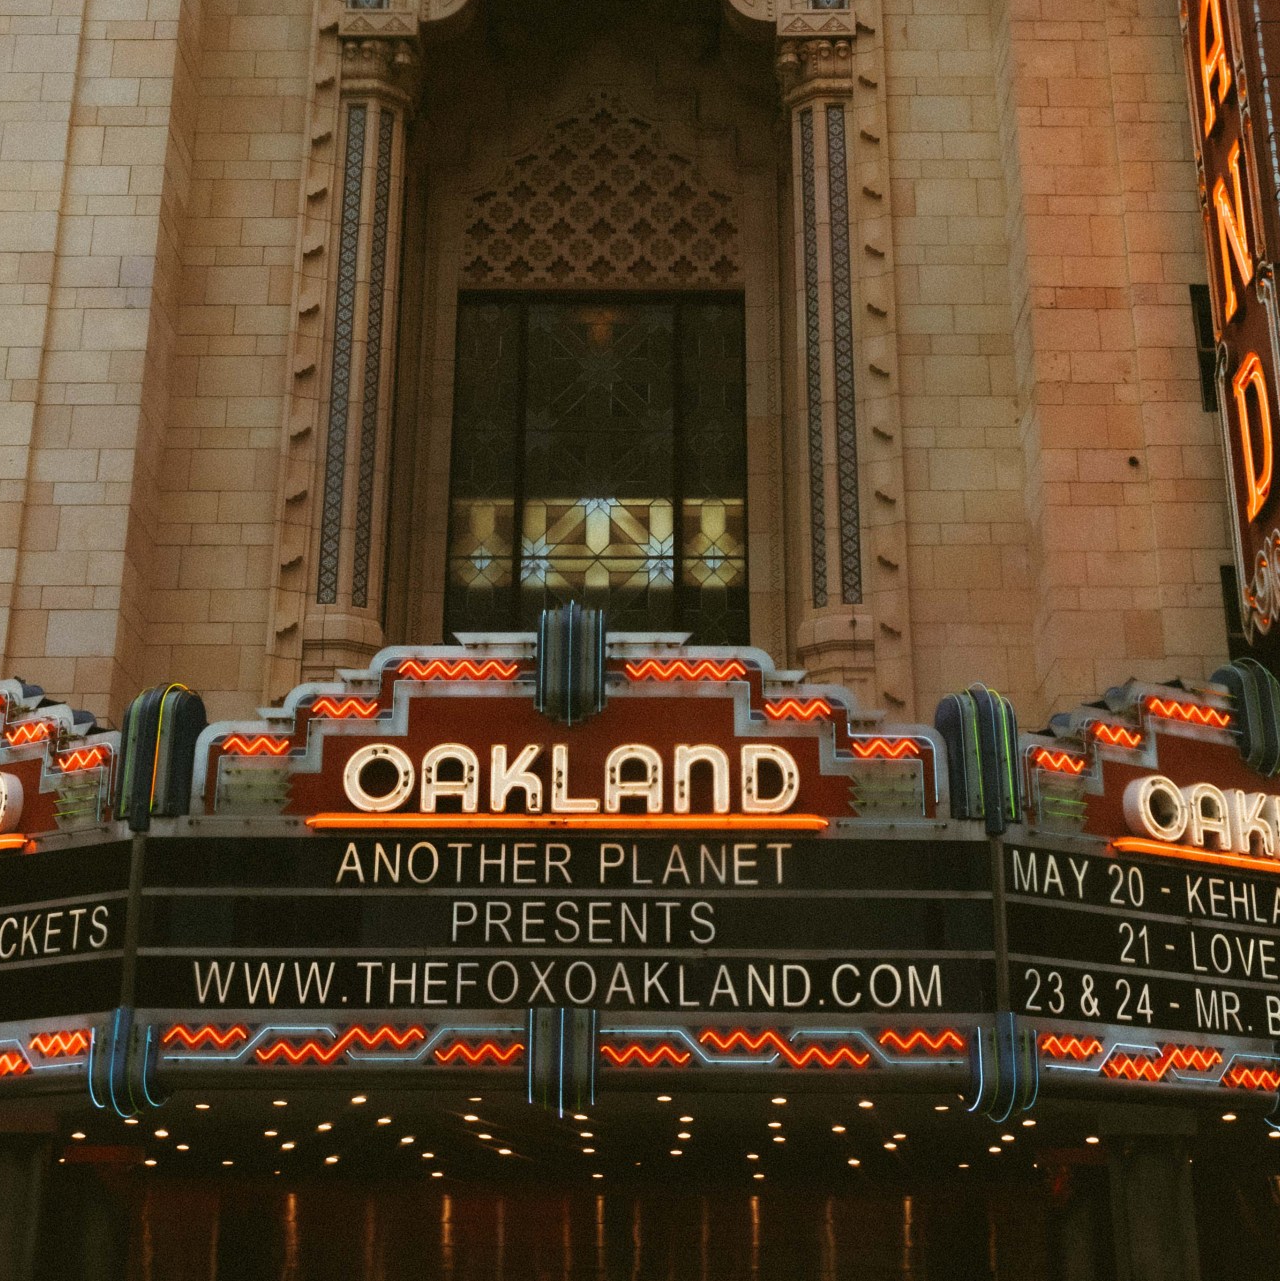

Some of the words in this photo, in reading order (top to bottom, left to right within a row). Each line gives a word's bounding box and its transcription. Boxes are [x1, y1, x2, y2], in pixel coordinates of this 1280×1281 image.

[342, 743, 800, 813] OAKLAND
[336, 842, 572, 884] ANOTHER
[600, 843, 793, 885] PLANET
[1012, 850, 1090, 900] MAY
[1108, 864, 1144, 907] 20
[452, 902, 717, 944] PRESENTS
[1119, 922, 1150, 966] 21
[1190, 933, 1276, 980] LOVE
[194, 961, 943, 1007] WWW.THEFOXOAKLAND.COM
[1025, 968, 1065, 1014] 23
[1081, 974, 1101, 1017] &
[1115, 979, 1154, 1023] 24
[1195, 988, 1253, 1032] MR.
